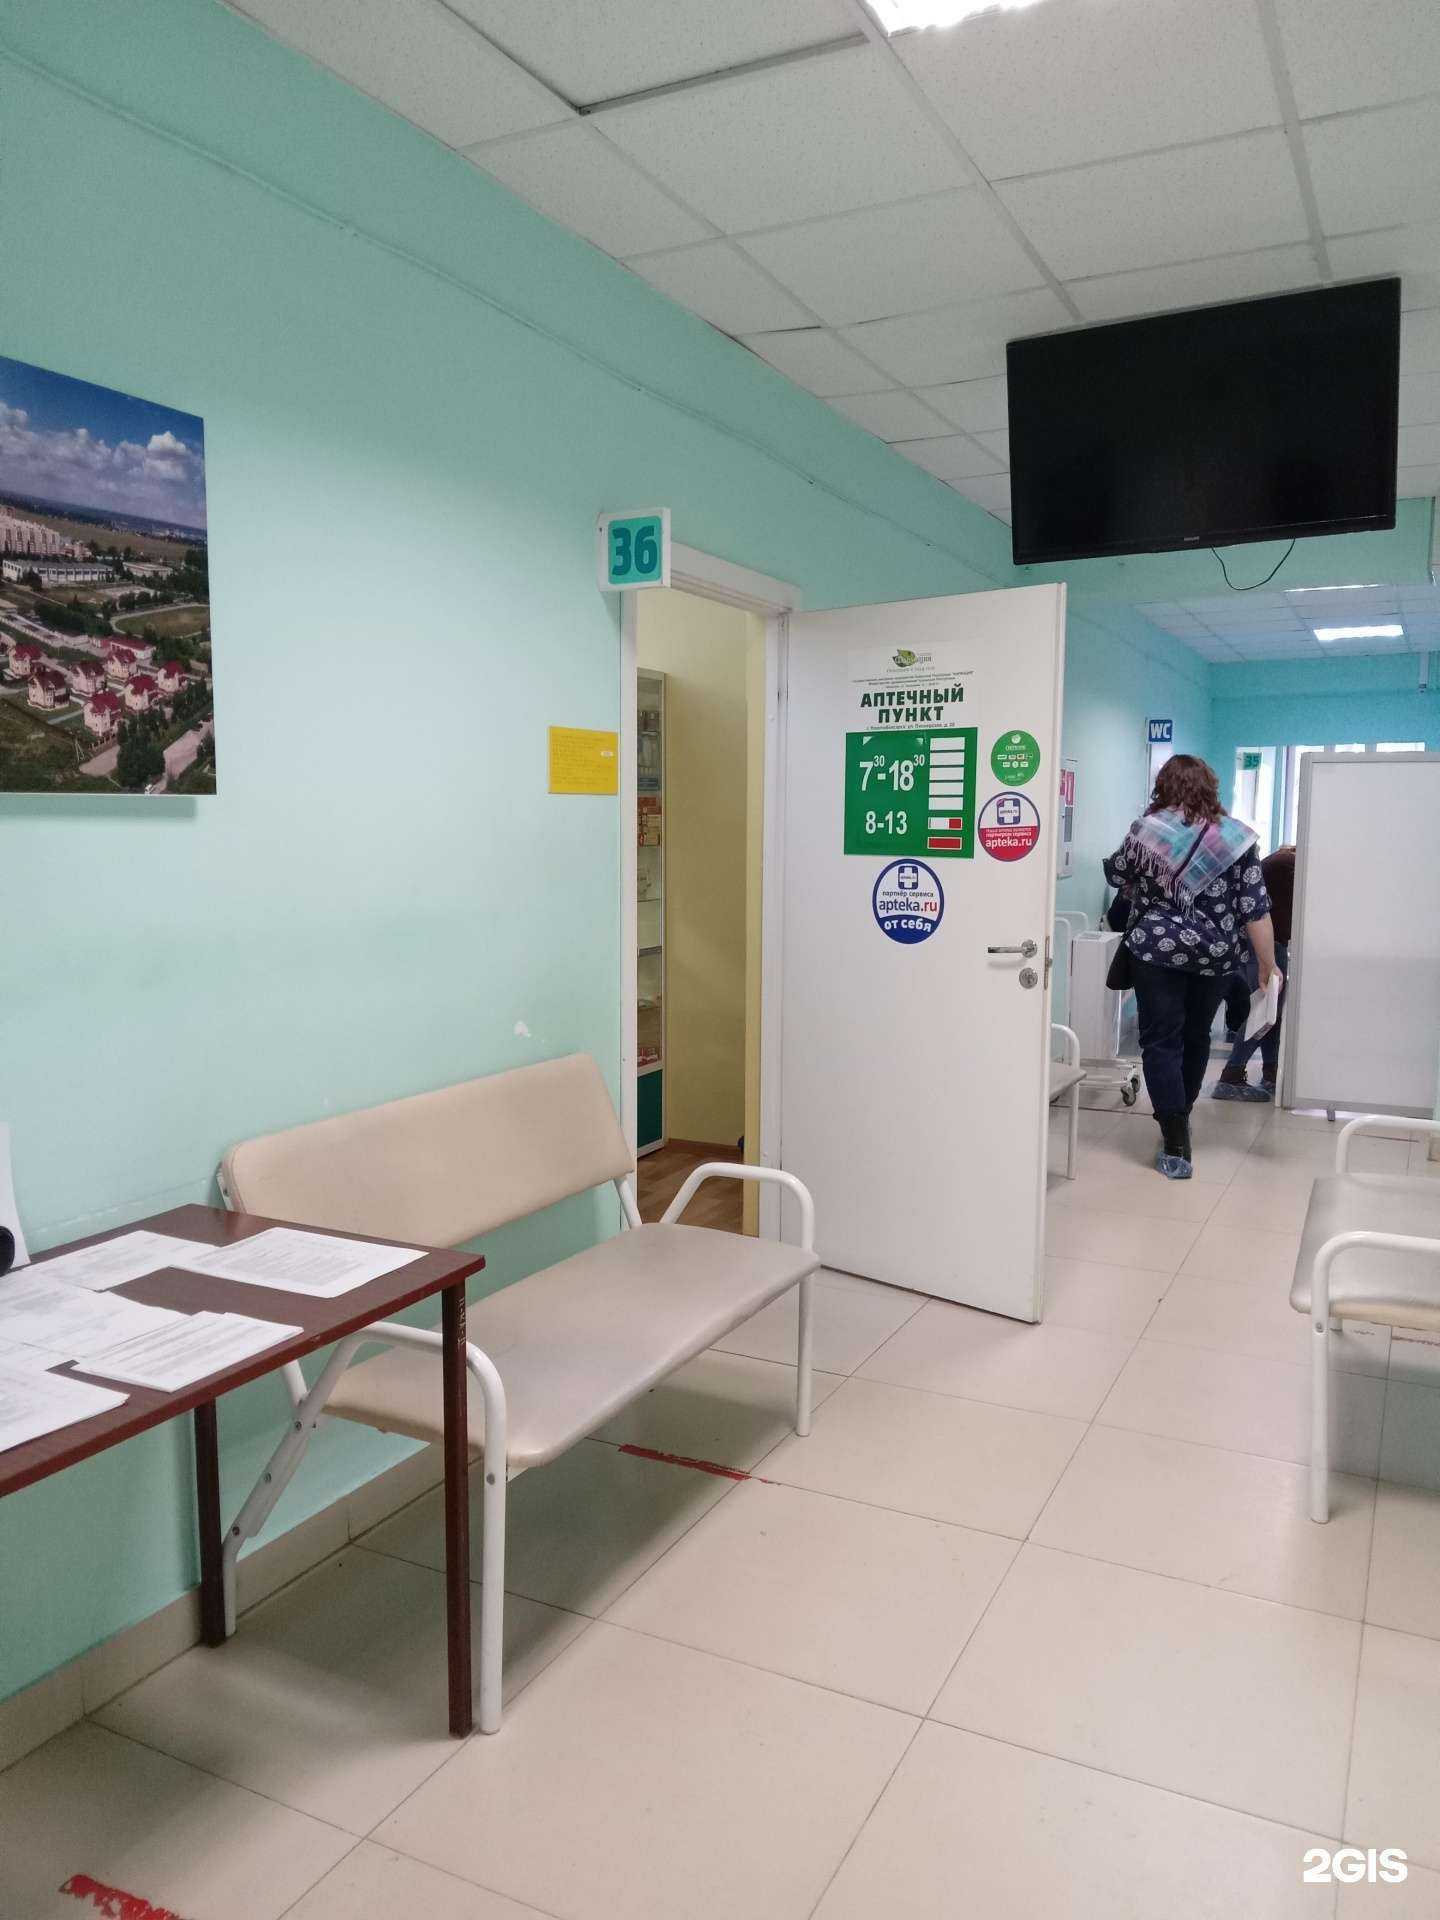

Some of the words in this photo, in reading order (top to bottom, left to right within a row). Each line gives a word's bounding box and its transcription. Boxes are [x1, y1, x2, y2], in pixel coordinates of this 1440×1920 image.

[612, 525, 658, 576] 36
[860, 683, 964, 708] АПТЕЧНЫЙ
[878, 706, 944, 723] ПУНКТ
[1150, 722, 1171, 739] WC
[865, 810, 908, 835] 8-13
[985, 837, 1032, 849] apteka.ru
[878, 898, 938, 913] apteka.ru
